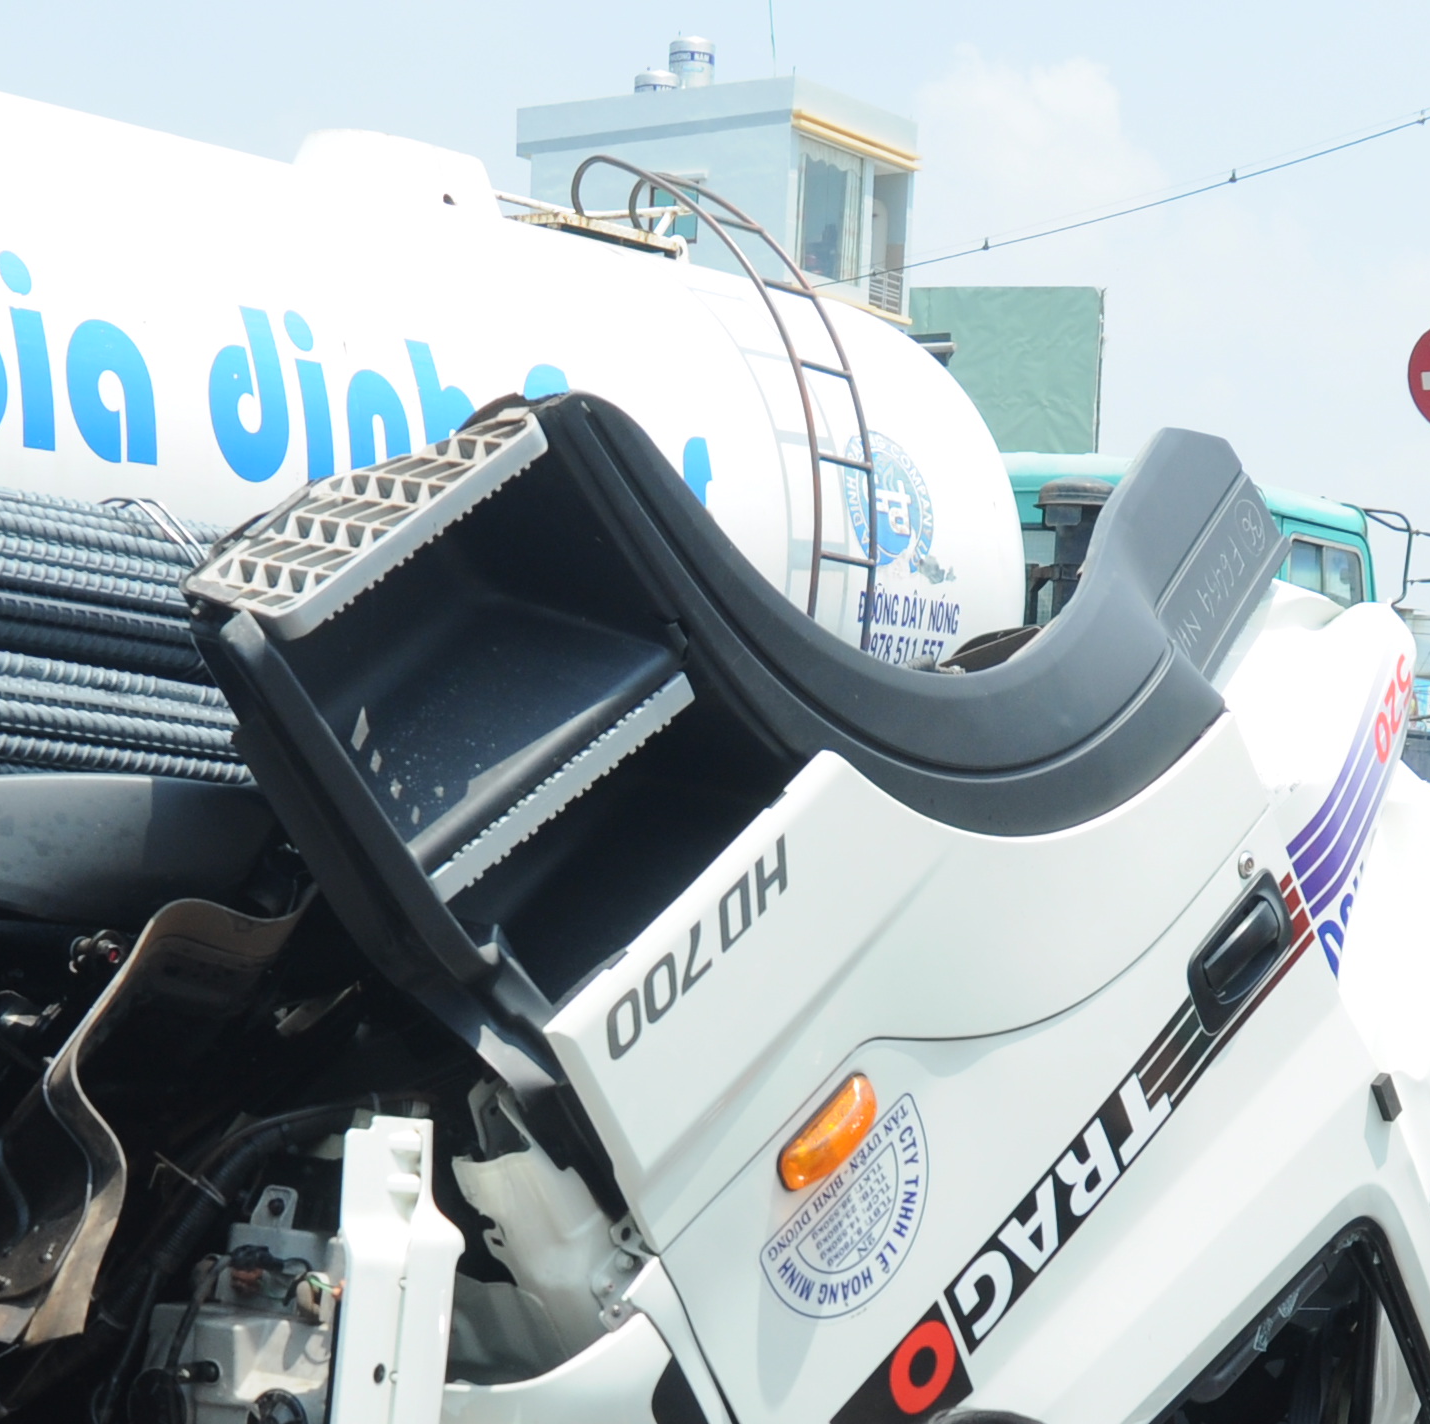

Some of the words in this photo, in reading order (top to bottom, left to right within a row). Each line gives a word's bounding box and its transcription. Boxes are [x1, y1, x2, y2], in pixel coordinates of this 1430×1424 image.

[901, 589, 926, 631] DÂY
[928, 594, 961, 635] NÓNG
[1372, 653, 1415, 765] 520
[719, 834, 789, 954] HD
[607, 922, 715, 1061] 700
[898, 1125, 920, 1167] CTY
[892, 1174, 920, 1239] TNHH
[875, 1240, 899, 1274] LÊ
[889, 1072, 1171, 1415] TRAGO
[777, 1256, 816, 1303] MINH
